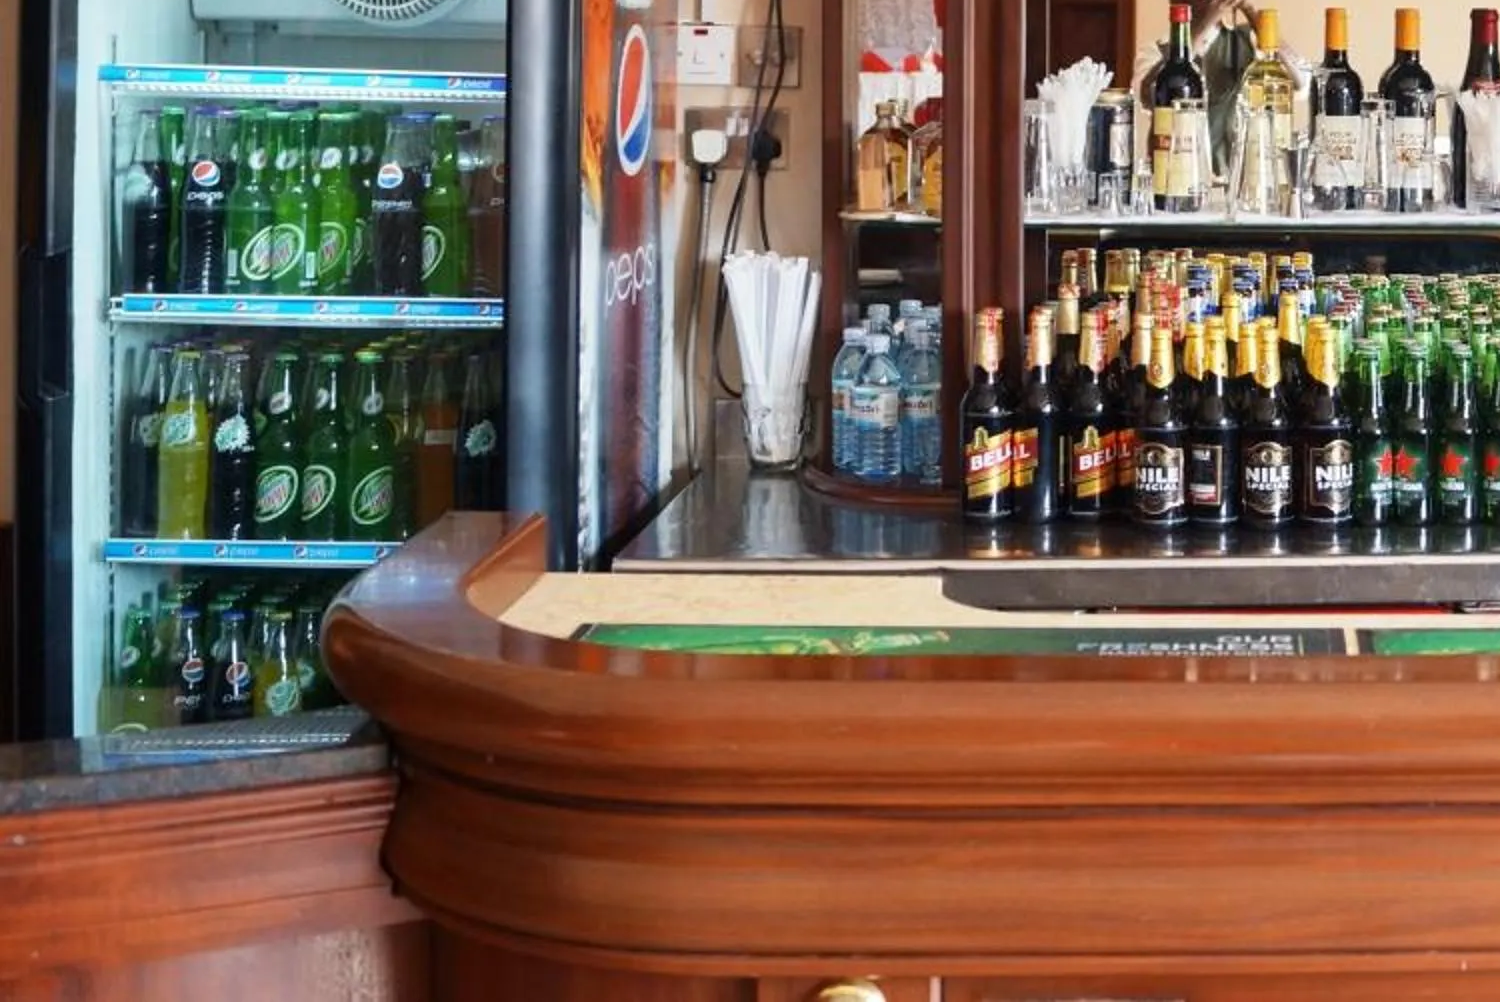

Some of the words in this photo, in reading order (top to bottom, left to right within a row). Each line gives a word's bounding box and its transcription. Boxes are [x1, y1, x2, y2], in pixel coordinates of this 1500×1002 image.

[604, 242, 656, 317] peps
[1135, 466, 1180, 484] NILE
[1245, 465, 1291, 483] NILE
